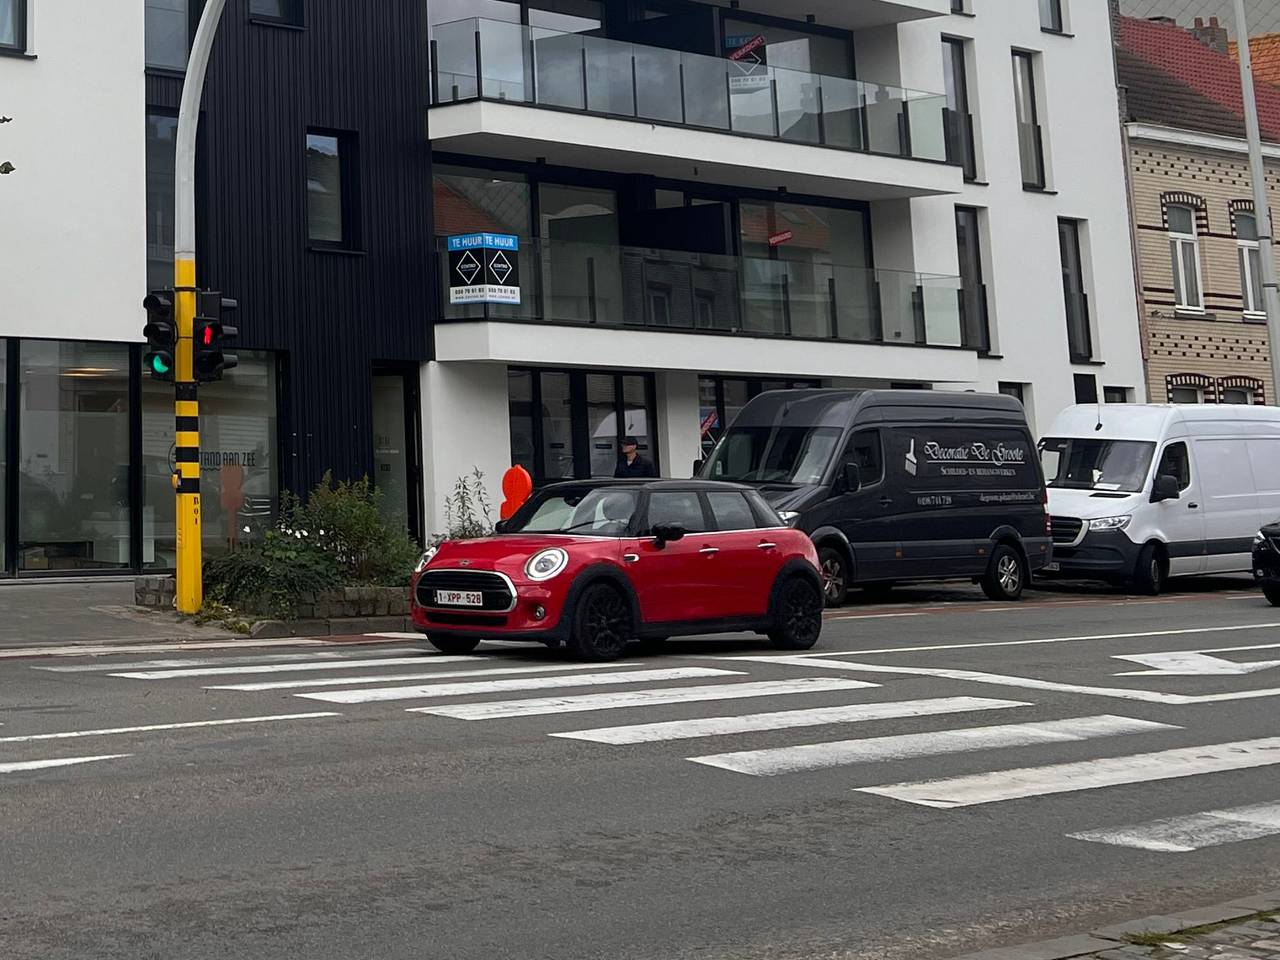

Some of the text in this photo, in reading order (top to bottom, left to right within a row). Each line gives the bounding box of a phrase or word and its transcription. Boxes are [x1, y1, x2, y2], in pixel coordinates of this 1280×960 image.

[452, 237, 483, 247] TE HUUR
[485, 237, 514, 247] TE HUUR
[923, 441, 969, 460] Decoratie
[971, 442, 990, 460] De
[200, 451, 256, 466] TAND AAN ZEE
[438, 591, 482, 604] 1-XPP-528
